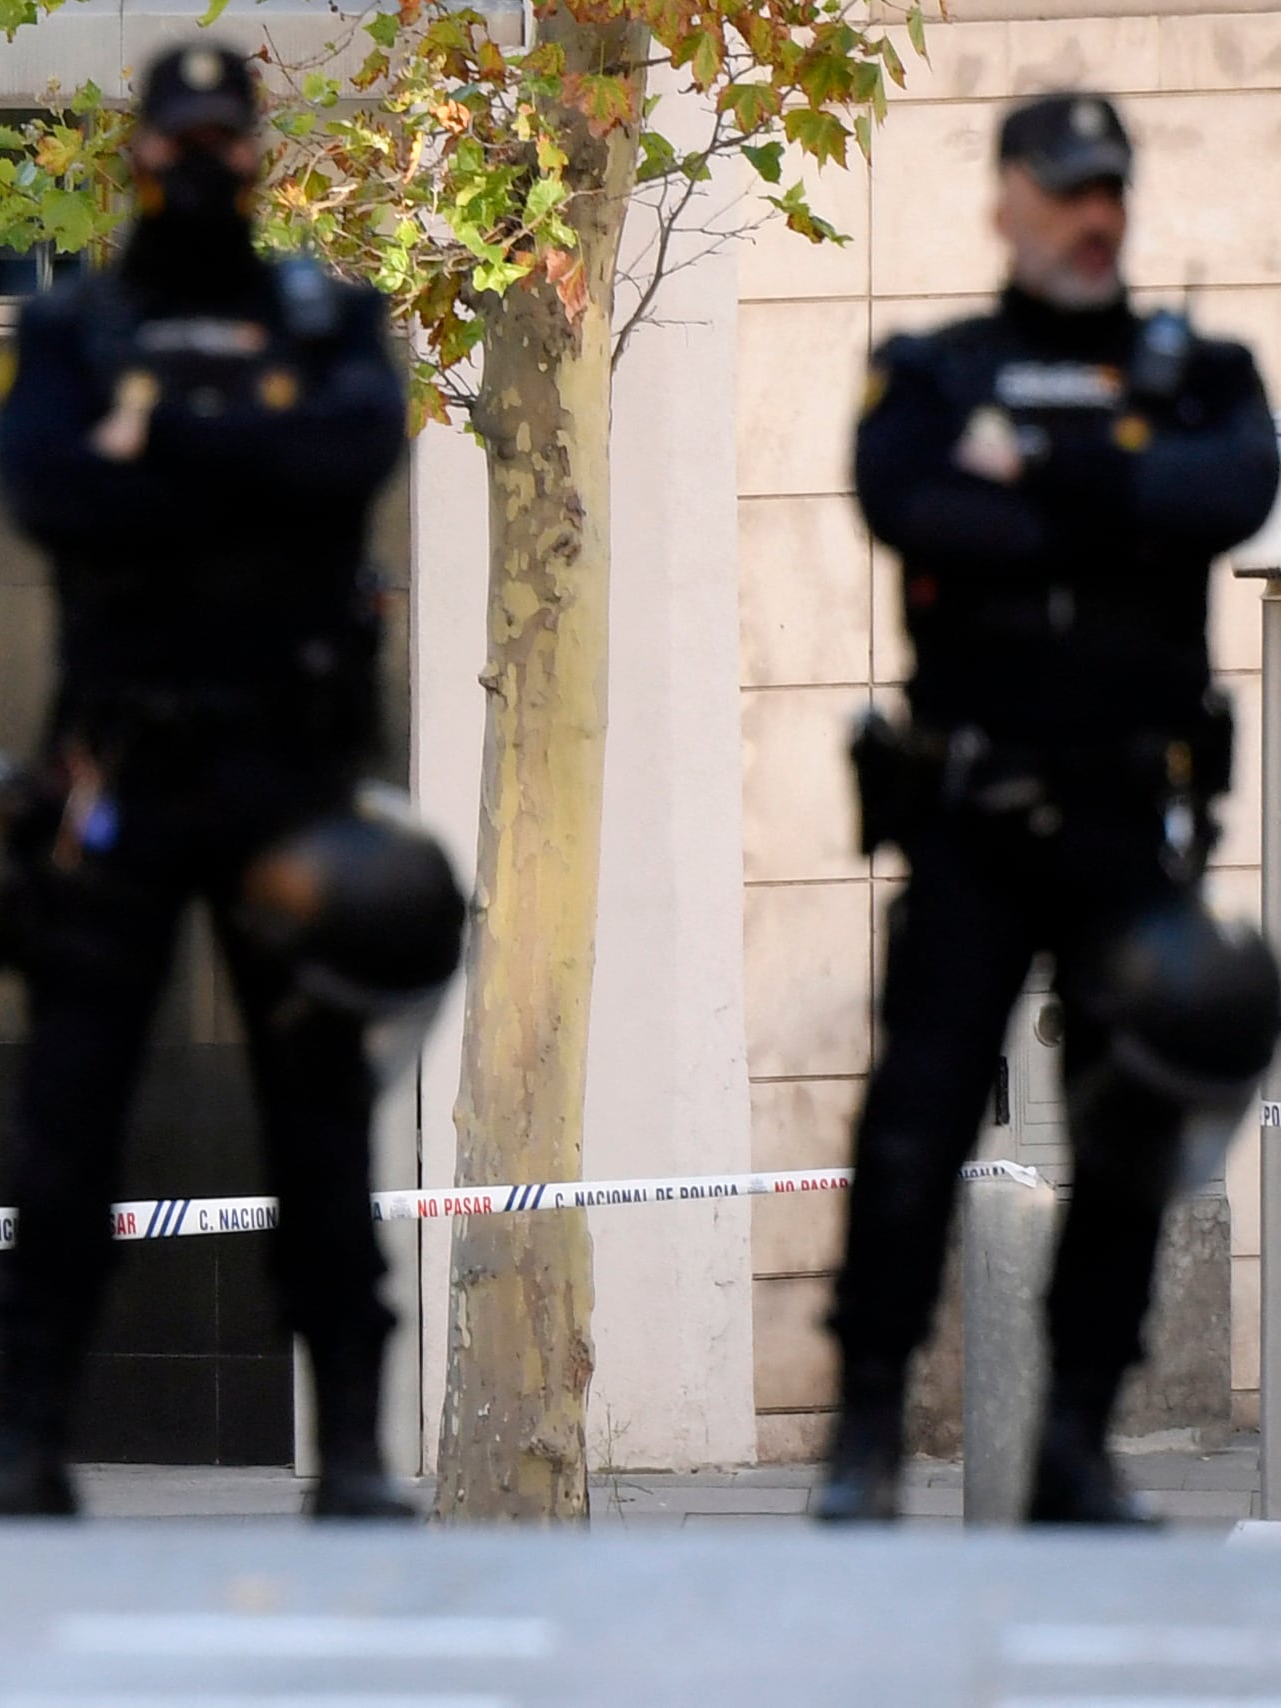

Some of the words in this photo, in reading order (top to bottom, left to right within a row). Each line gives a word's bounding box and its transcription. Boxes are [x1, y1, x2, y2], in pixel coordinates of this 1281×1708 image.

[1264, 1105, 1280, 1127] PO
[199, 1209, 214, 1232] C.
[219, 1205, 279, 1231] NACION
[418, 1199, 438, 1217] NO
[444, 1196, 493, 1216] PASAR
